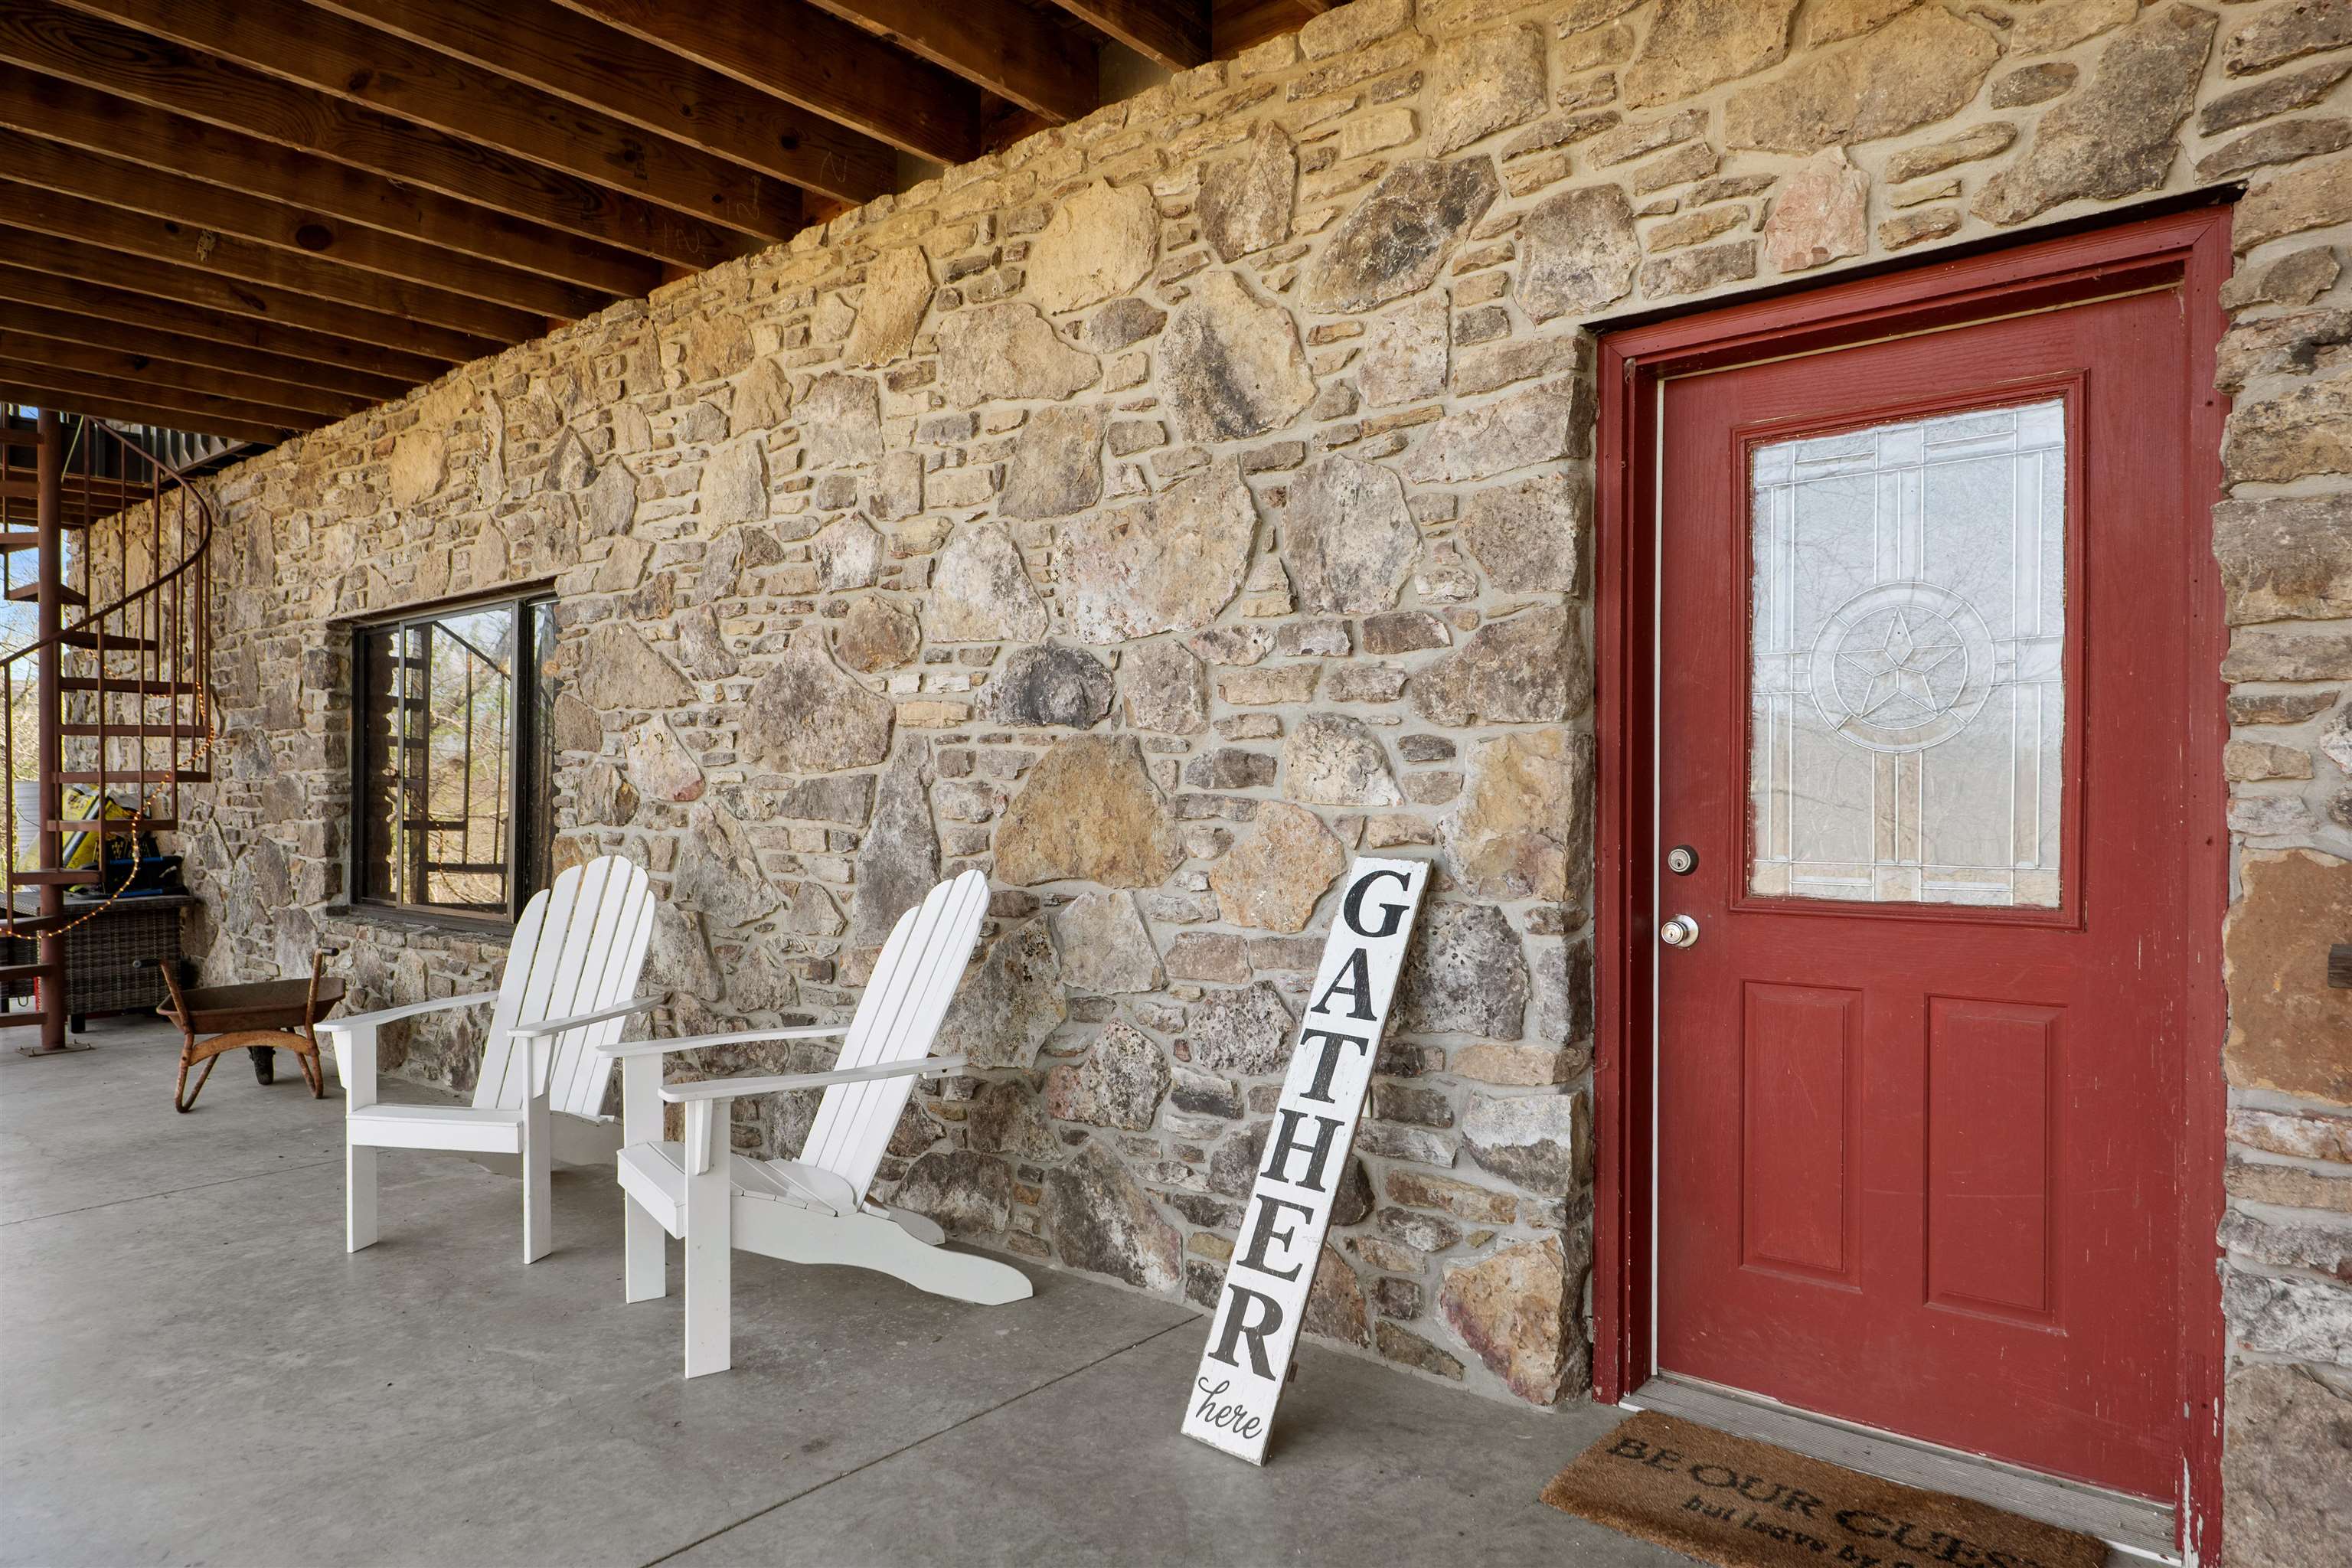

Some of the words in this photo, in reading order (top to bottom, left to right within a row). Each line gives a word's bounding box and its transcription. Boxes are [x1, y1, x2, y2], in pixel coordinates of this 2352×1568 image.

[1207, 870, 1411, 1381] GATHER
[1195, 1377, 1263, 1439] here
[1606, 1437, 1684, 1474] BE
[1687, 1463, 1826, 1519] OUR
